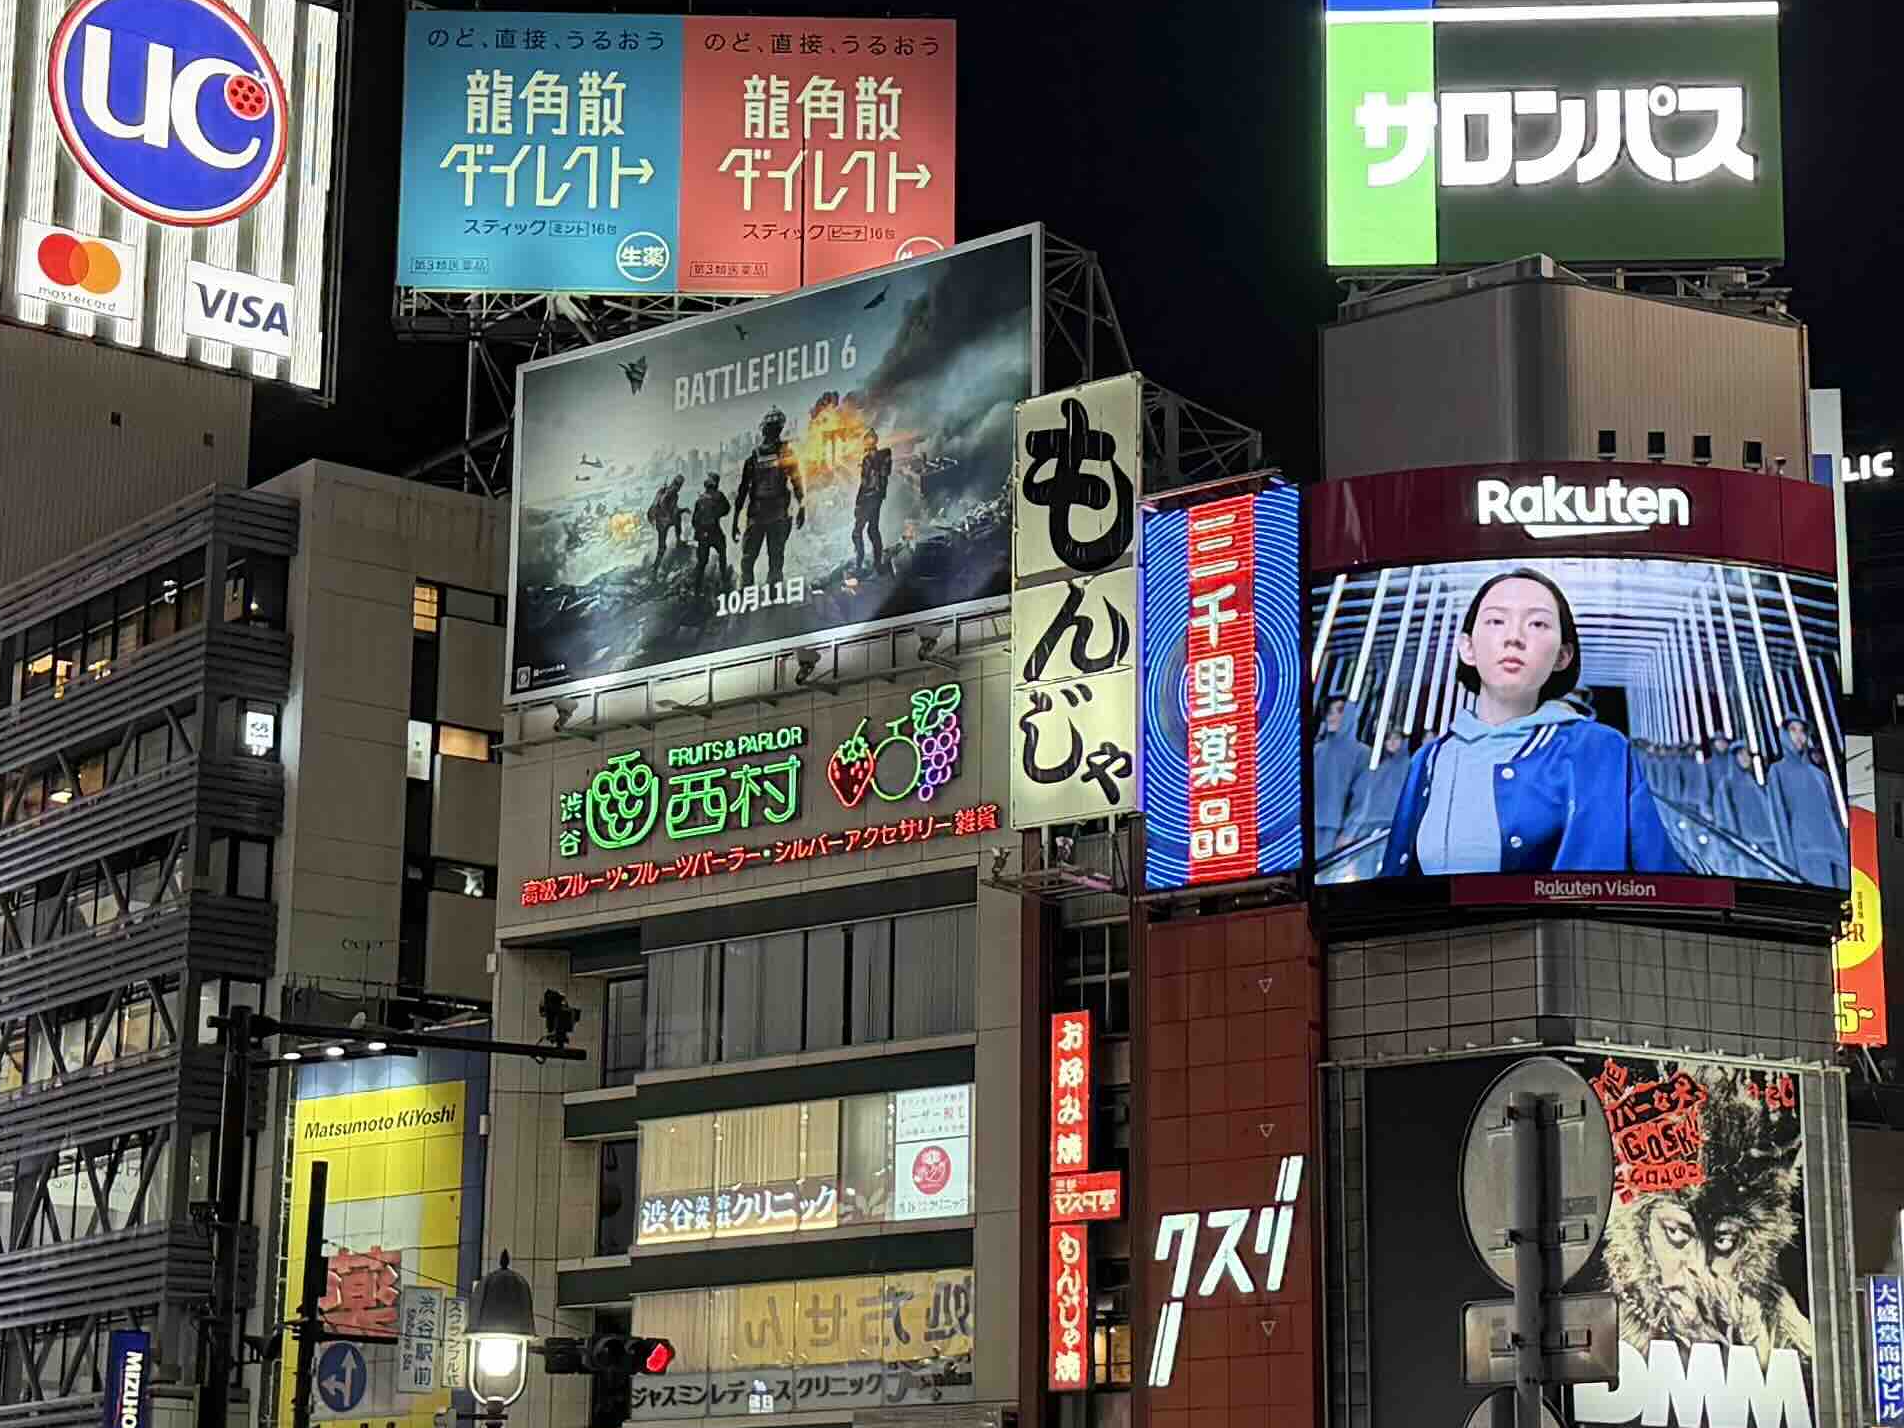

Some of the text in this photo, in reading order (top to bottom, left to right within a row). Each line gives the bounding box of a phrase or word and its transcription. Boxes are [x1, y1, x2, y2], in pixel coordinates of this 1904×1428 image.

[427, 27, 667, 52] のど、直接、うるおう
[704, 31, 941, 57] のど、直接、うるおう
[466, 69, 627, 137] 龍角散
[743, 74, 903, 141] 龍角散
[1354, 84, 1759, 188] サロンパス
[439, 143, 655, 210] ダイレクト
[717, 147, 933, 214] ダイレクト
[463, 218, 547, 237] スティック
[552, 221, 587, 236] ミント
[618, 243, 666, 271] 生薬
[742, 223, 825, 242] スティック
[830, 226, 865, 240] ピーチ
[37, 283, 118, 314] mastercard
[191, 281, 290, 338] VISA
[673, 332, 858, 413] BATTLEFIELD 6
[1476, 475, 1690, 528] Rakuten
[716, 576, 805, 618] 10月11日
[1021, 397, 1134, 806] もんじゃ
[1189, 513, 1240, 860] 三千里薬品
[559, 791, 583, 857] 渋谷
[665, 754, 800, 840] 西村
[1534, 879, 1657, 899] Rakuten Vision
[303, 1103, 457, 1141] Matsumoto KiYoshi
[1056, 1019, 1085, 1165] お好み焼
[1054, 1231, 1083, 1384] もんじゃ焼
[631, 1372, 882, 1410] ジャスミンレデースクリニック
